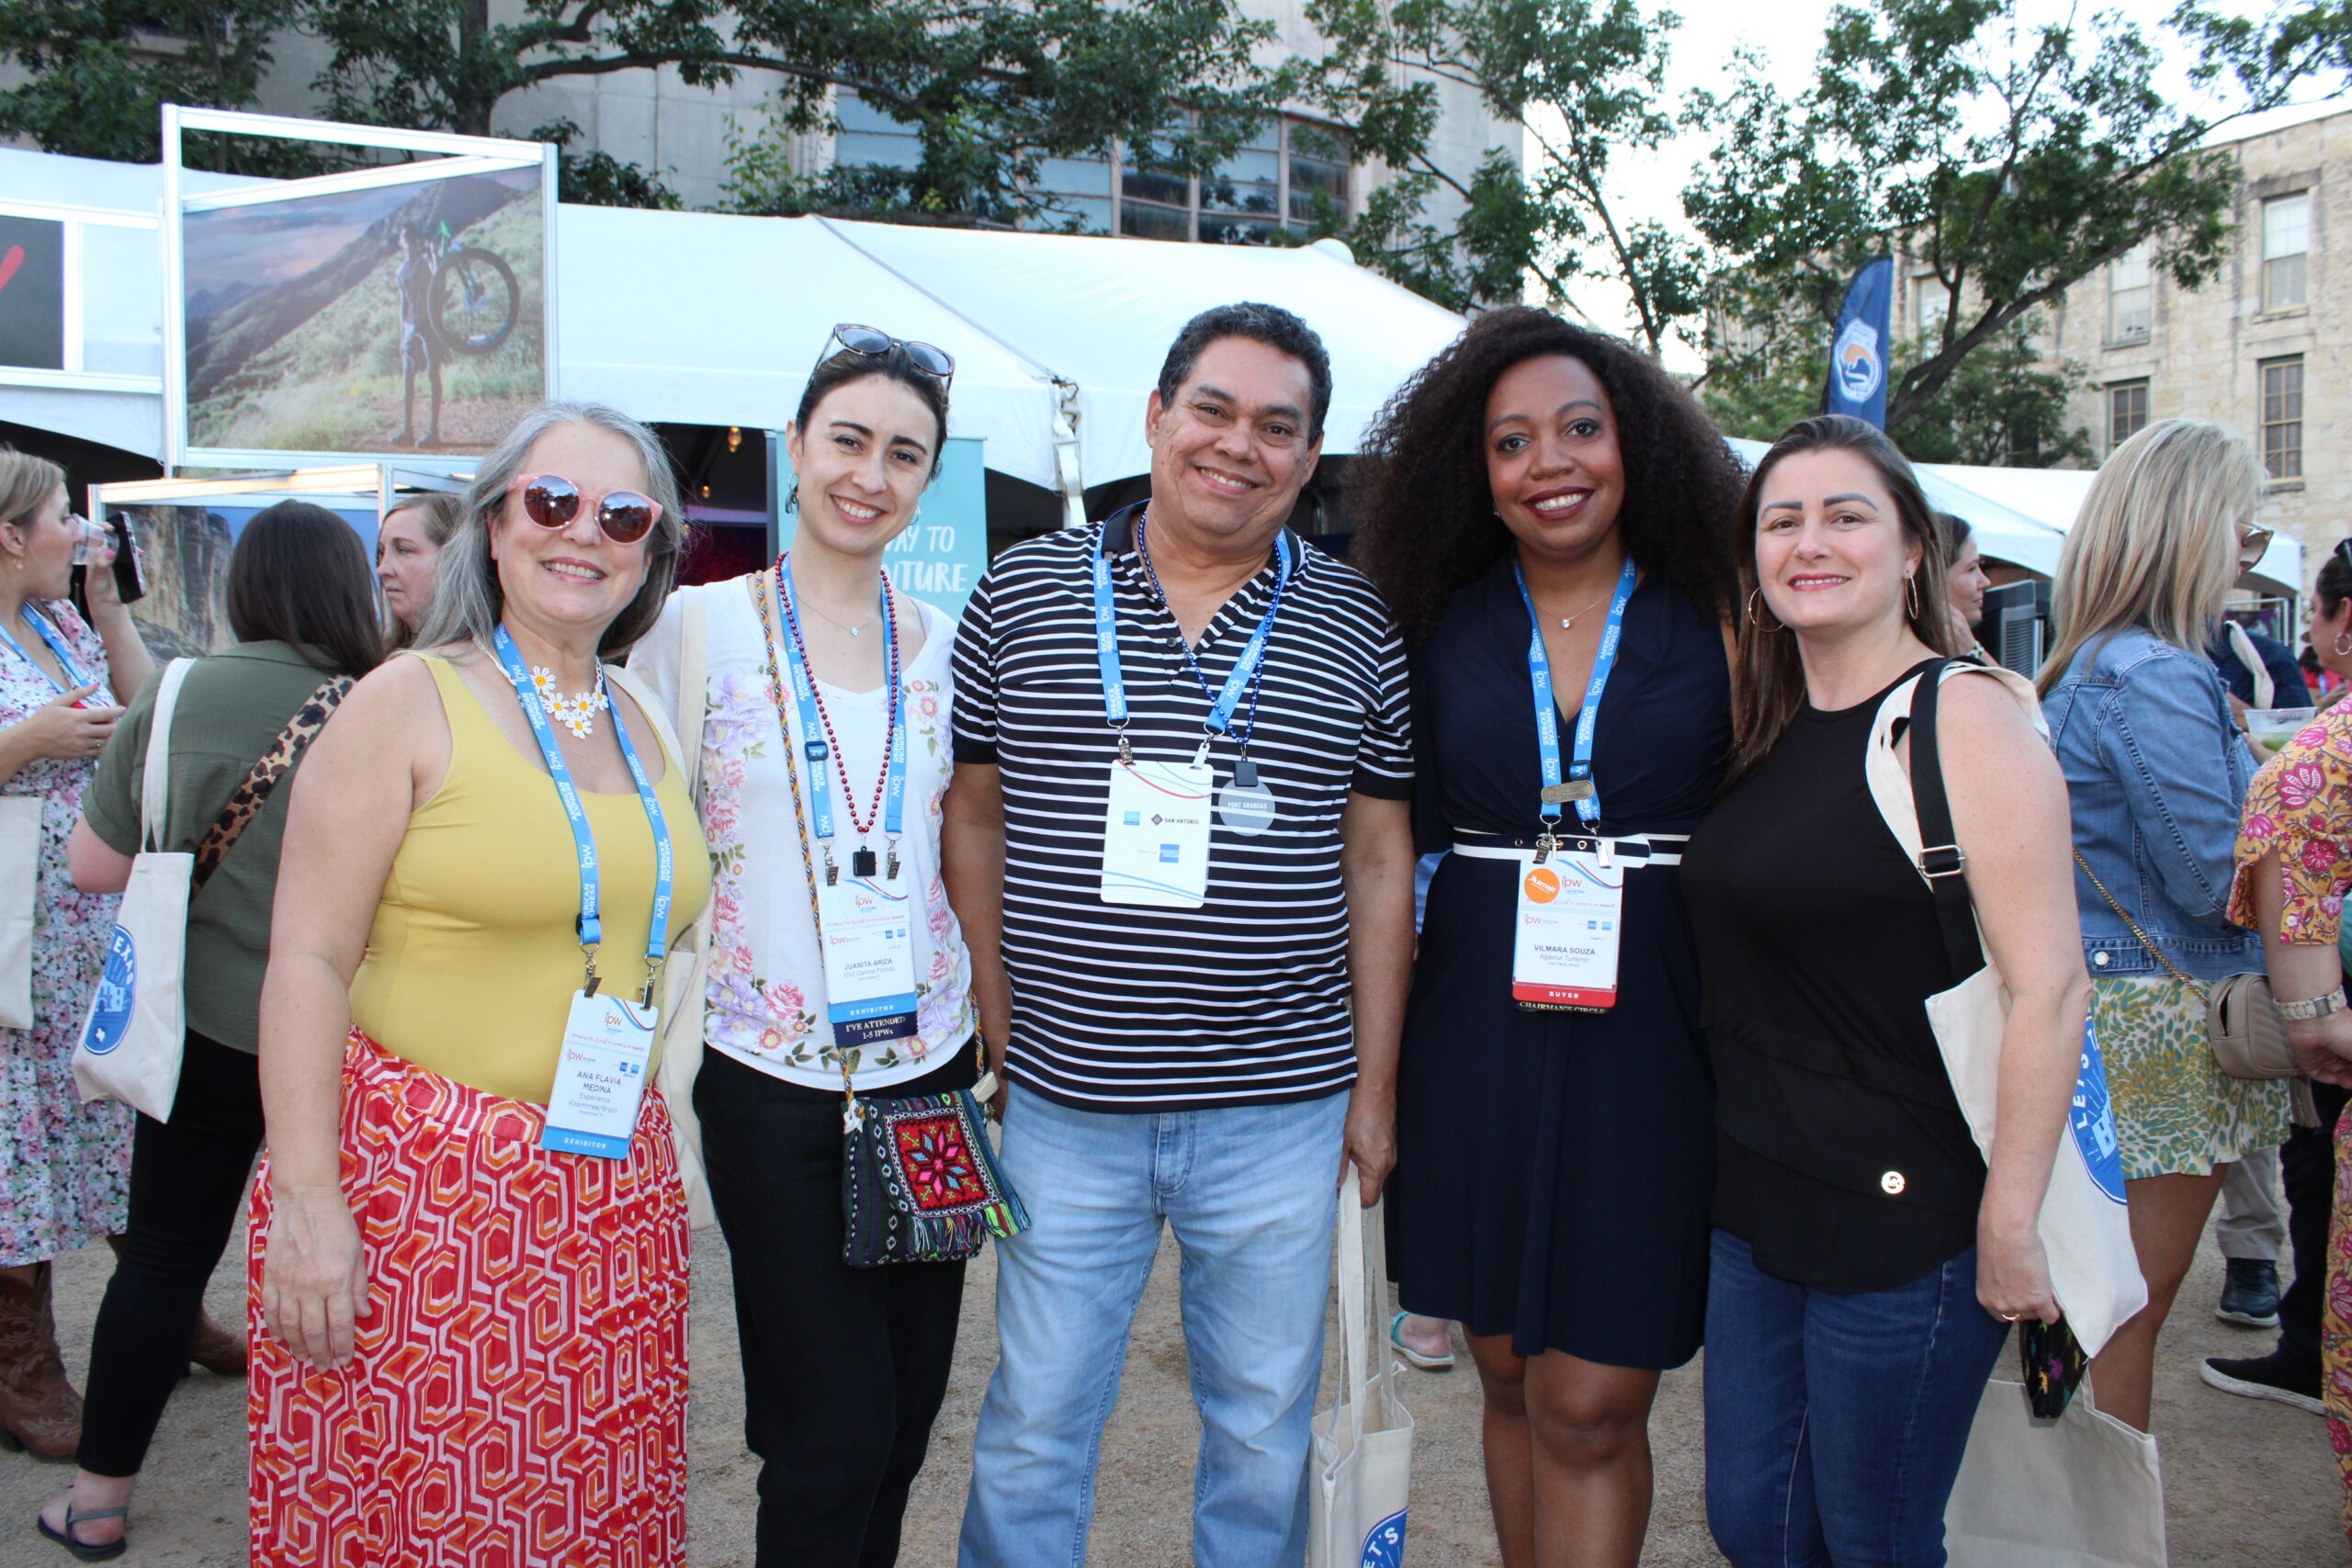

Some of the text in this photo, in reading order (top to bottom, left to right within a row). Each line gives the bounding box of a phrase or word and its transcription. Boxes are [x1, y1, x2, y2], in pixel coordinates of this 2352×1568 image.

[926, 525, 955, 553] TO
[1096, 605, 1112, 623] ipw
[1532, 628, 1544, 661] AMERICAN
[1600, 625, 1615, 660] AMERICAN
[1607, 626, 1621, 656] EXPRESS
[793, 664, 807, 702] AMERICAN
[1226, 678, 1245, 698] ipw
[1534, 671, 1548, 689] ipw
[1588, 678, 1603, 696] ipw
[1108, 689, 1117, 719] EXPRES
[807, 721, 820, 741] ipw
[1540, 711, 1548, 746] EXPRESS
[1545, 706, 1555, 746] AMERICAN
[1578, 706, 1590, 745] AMERICAN
[1585, 705, 1596, 740] EXPRESS
[547, 750, 565, 771] ipw
[1544, 758, 1559, 780] ipw
[891, 775, 905, 797] ipw
[644, 797, 660, 817] ipw
[819, 815, 831, 837] ipw
[580, 844, 596, 869] ipw
[662, 838, 671, 882] AMERICAN
[1561, 875, 1582, 889] ipw
[582, 883, 591, 919] ERICAN
[656, 896, 671, 919] ipw
[854, 896, 874, 908] ipw
[1524, 914, 1543, 925] ipw
[830, 936, 846, 946] ipw
[1534, 944, 1595, 955] VILMARA SOUZA
[112, 933, 134, 985] EXAS
[844, 957, 893, 971] JUANITA ARIZA
[1565, 954, 1589, 964] Turismo
[843, 970, 855, 978] Visit
[856, 968, 875, 977] Central
[1548, 991, 1579, 999] BUYER
[850, 1005, 895, 1016] EXHIBITOR
[1519, 1001, 1573, 1012] CHAIRMAN'S
[605, 1011, 623, 1027] ipw
[845, 1016, 906, 1032] I'VE ATTENDED
[863, 1028, 894, 1039] 1-5 IPWs
[567, 1048, 583, 1061] ipw
[576, 1070, 594, 1080] ANA
[595, 1074, 622, 1085] FLAVIA
[582, 1083, 612, 1094] MEDINA
[568, 1100, 617, 1113] Kissimmee/Brazil
[579, 1092, 611, 1104] Experience
[564, 1137, 607, 1149] EXHIBITOR
